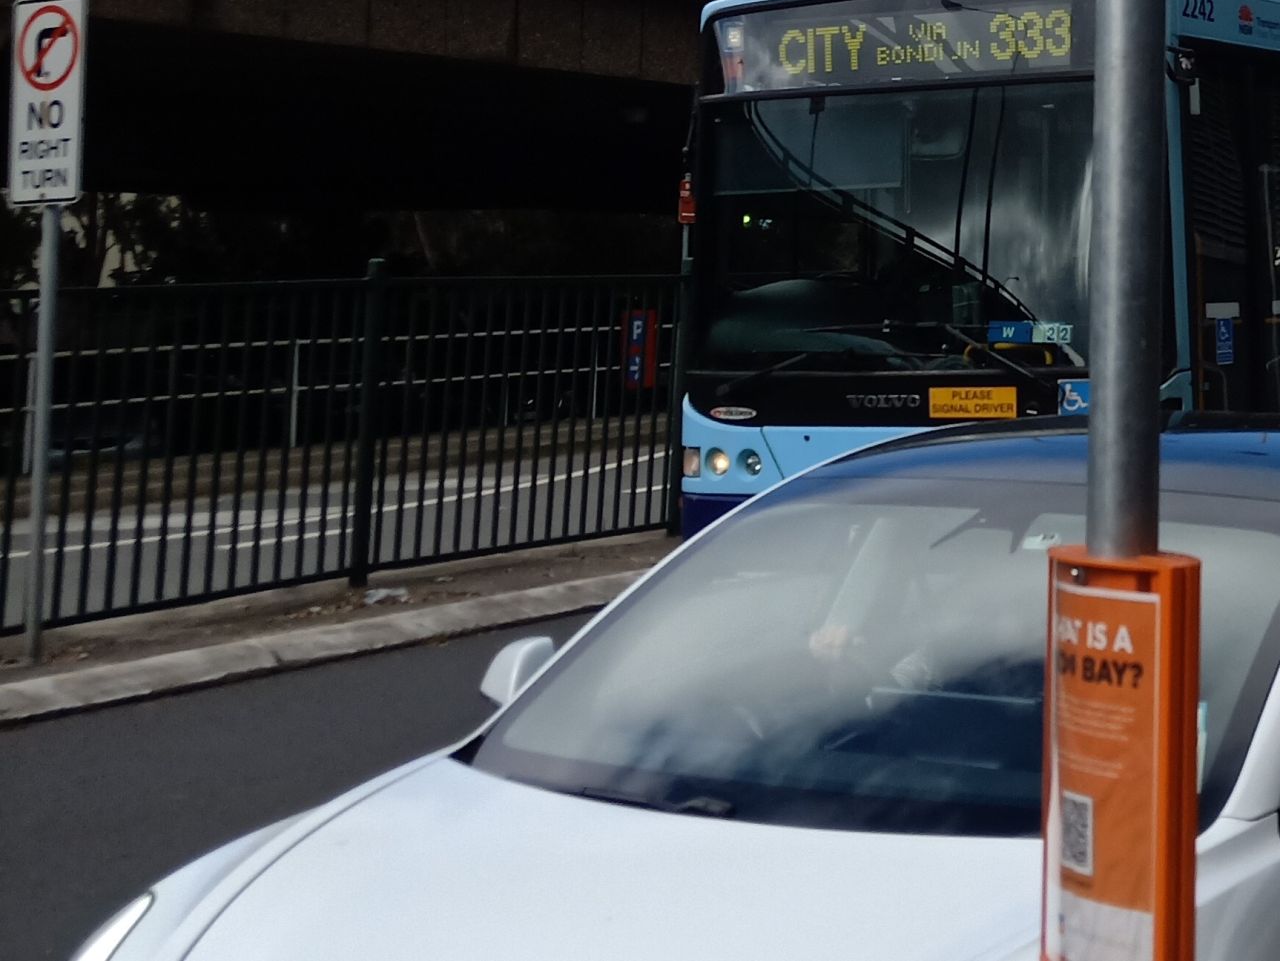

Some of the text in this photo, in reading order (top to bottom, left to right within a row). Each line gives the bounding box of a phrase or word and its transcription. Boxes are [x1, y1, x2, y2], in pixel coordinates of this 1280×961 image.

[778, 8, 1072, 75] CITY VIA 333
[876, 40, 980, 66] BONDI JN
[27, 99, 65, 131] NO
[18, 137, 72, 161] RIGHT
[21, 168, 68, 189] TURN
[1002, 326, 1015, 338] W
[846, 393, 921, 409] VOLVO
[951, 389, 993, 401] PLEASE
[931, 402, 1014, 414] SIGNAL DRIVER
[1086, 621, 1108, 651] IS
[1112, 624, 1134, 655] A
[1081, 655, 1144, 690] BAY?
